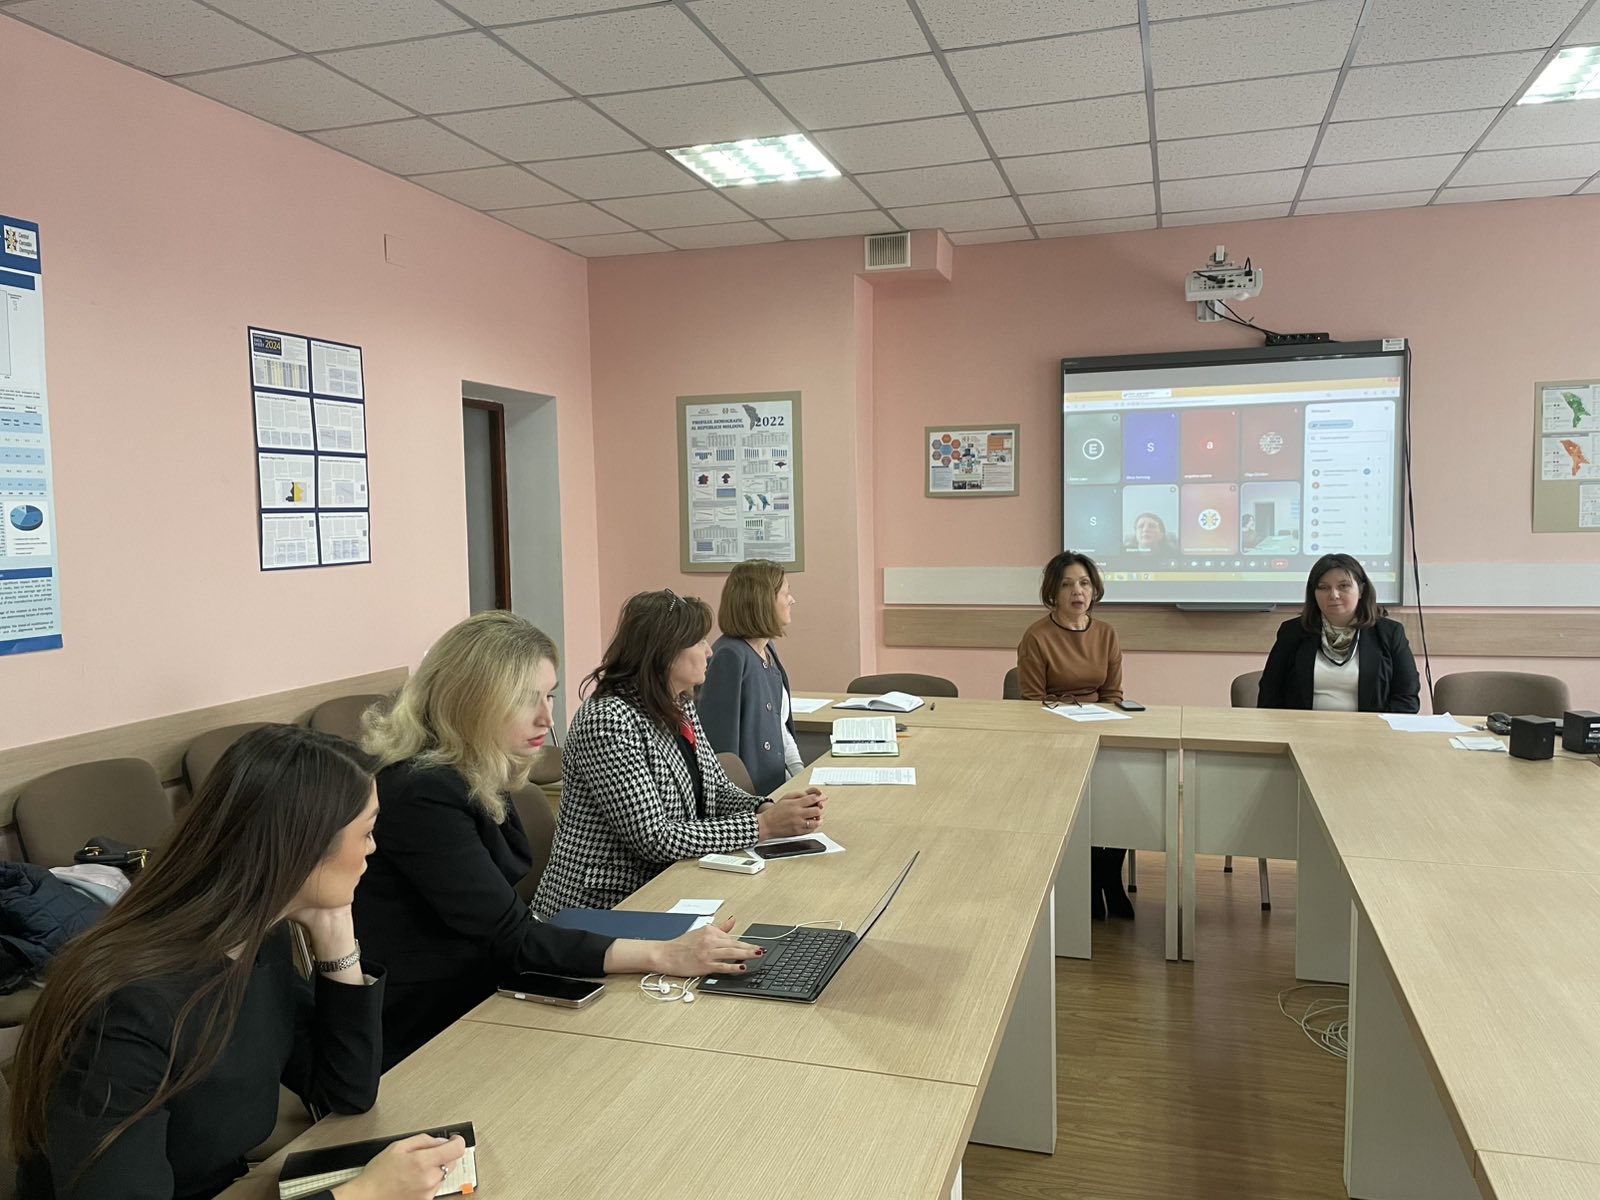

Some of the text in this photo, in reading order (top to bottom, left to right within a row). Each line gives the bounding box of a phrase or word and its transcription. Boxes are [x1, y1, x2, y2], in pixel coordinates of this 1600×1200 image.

[265, 339, 281, 350] 2024
[755, 416, 785, 427] 2022
[1088, 443, 1098, 455] E
[1146, 442, 1155, 453] S
[1206, 441, 1214, 450] a
[1089, 516, 1097, 526] S
